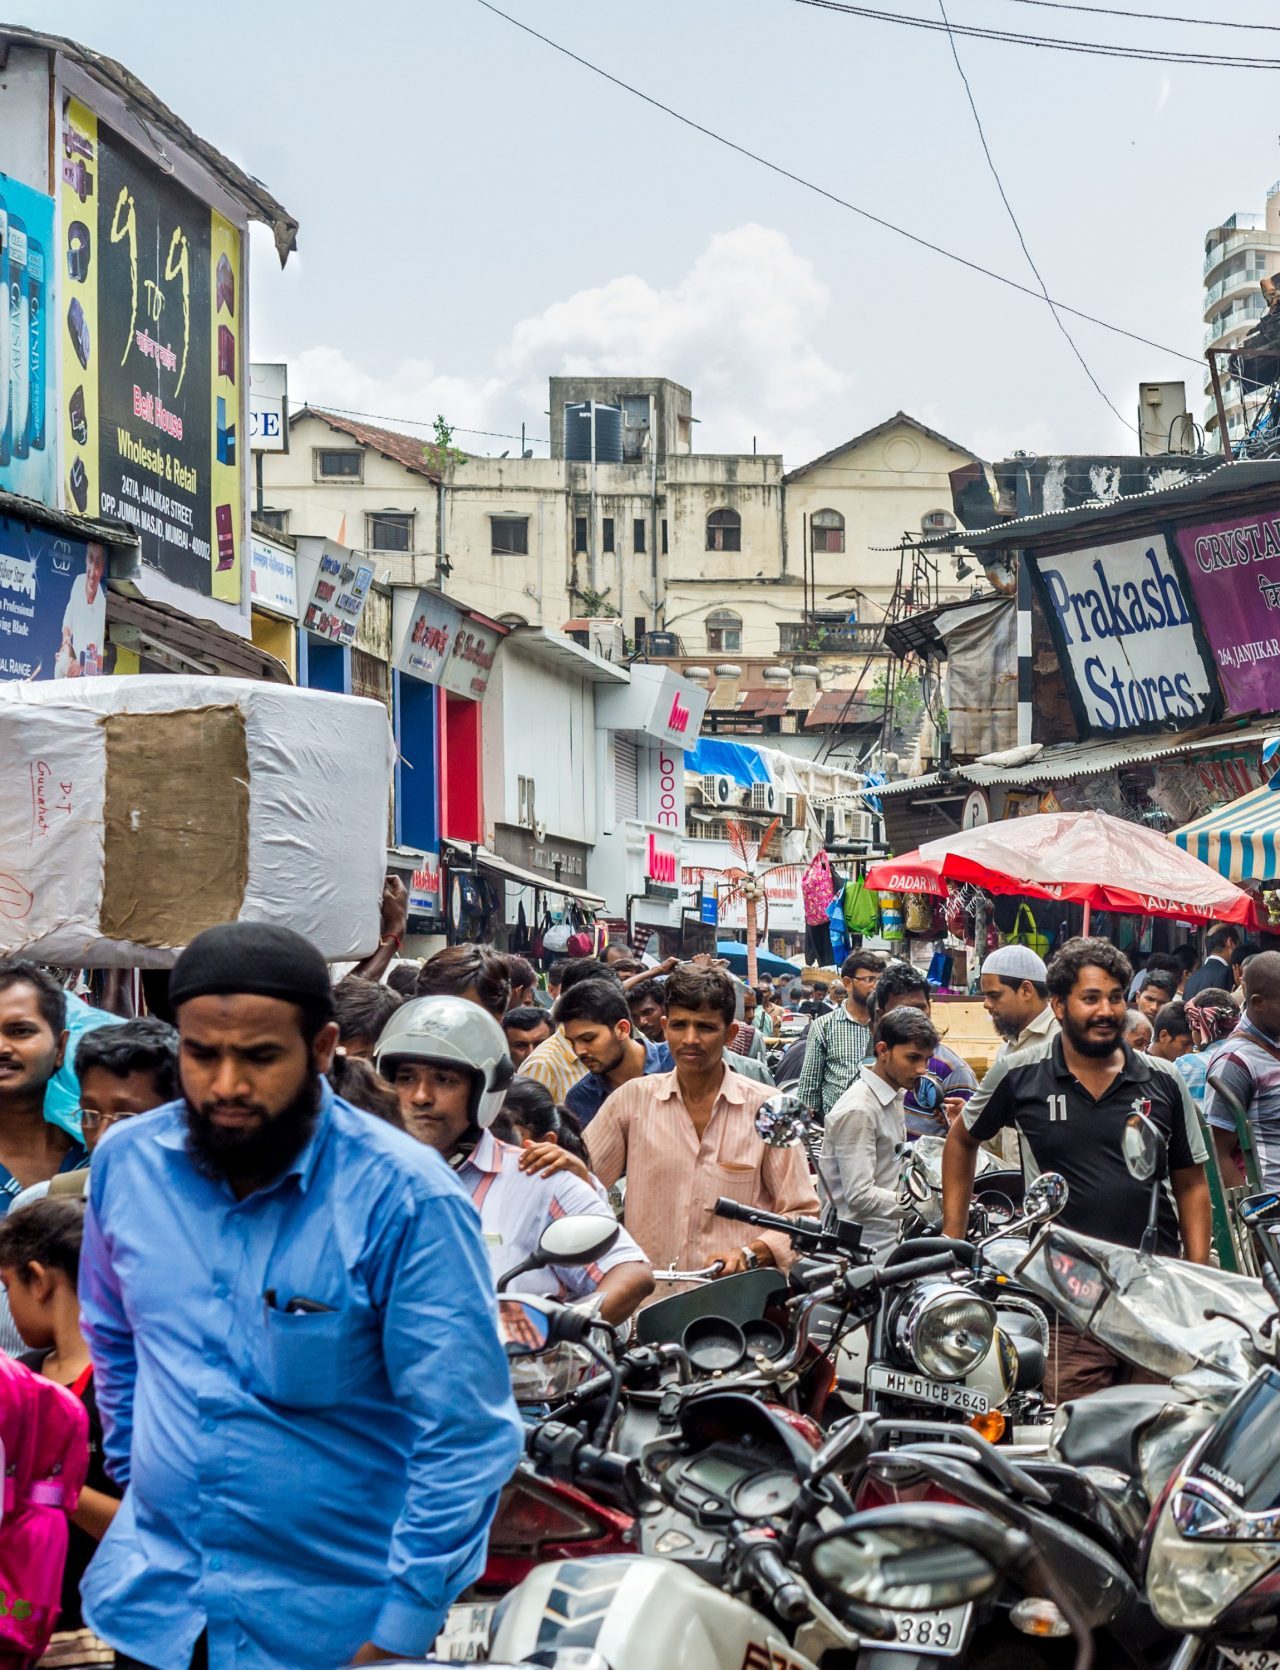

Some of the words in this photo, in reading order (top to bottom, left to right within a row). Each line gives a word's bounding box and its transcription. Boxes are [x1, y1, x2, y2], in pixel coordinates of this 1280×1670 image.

[31, 297, 40, 380] GATSBY
[133, 384, 154, 425] Belt
[155, 396, 183, 441] House
[118, 427, 164, 477] Wholesale
[165, 454, 173, 481] &
[173, 458, 197, 490] Retail
[101, 492, 117, 516] OPP.
[117, 500, 140, 528] JUMMA
[165, 522, 189, 550] MUMBAI
[170, 500, 194, 531] STREET,
[3, 598, 35, 618] Professional
[1043, 547, 1193, 645] Prakash
[12, 619, 30, 637] Blade
[9, 659, 32, 677] RANGE
[1218, 648, 1236, 668] 264,
[1084, 655, 1204, 731] Stores
[888, 874, 927, 891] DADAR
[1046, 1094, 1067, 1121] 11
[886, 1373, 906, 1392] MH
[914, 1380, 949, 1402] 01CB
[954, 1390, 987, 1412] 2649
[1199, 1462, 1245, 1498] HONDA
